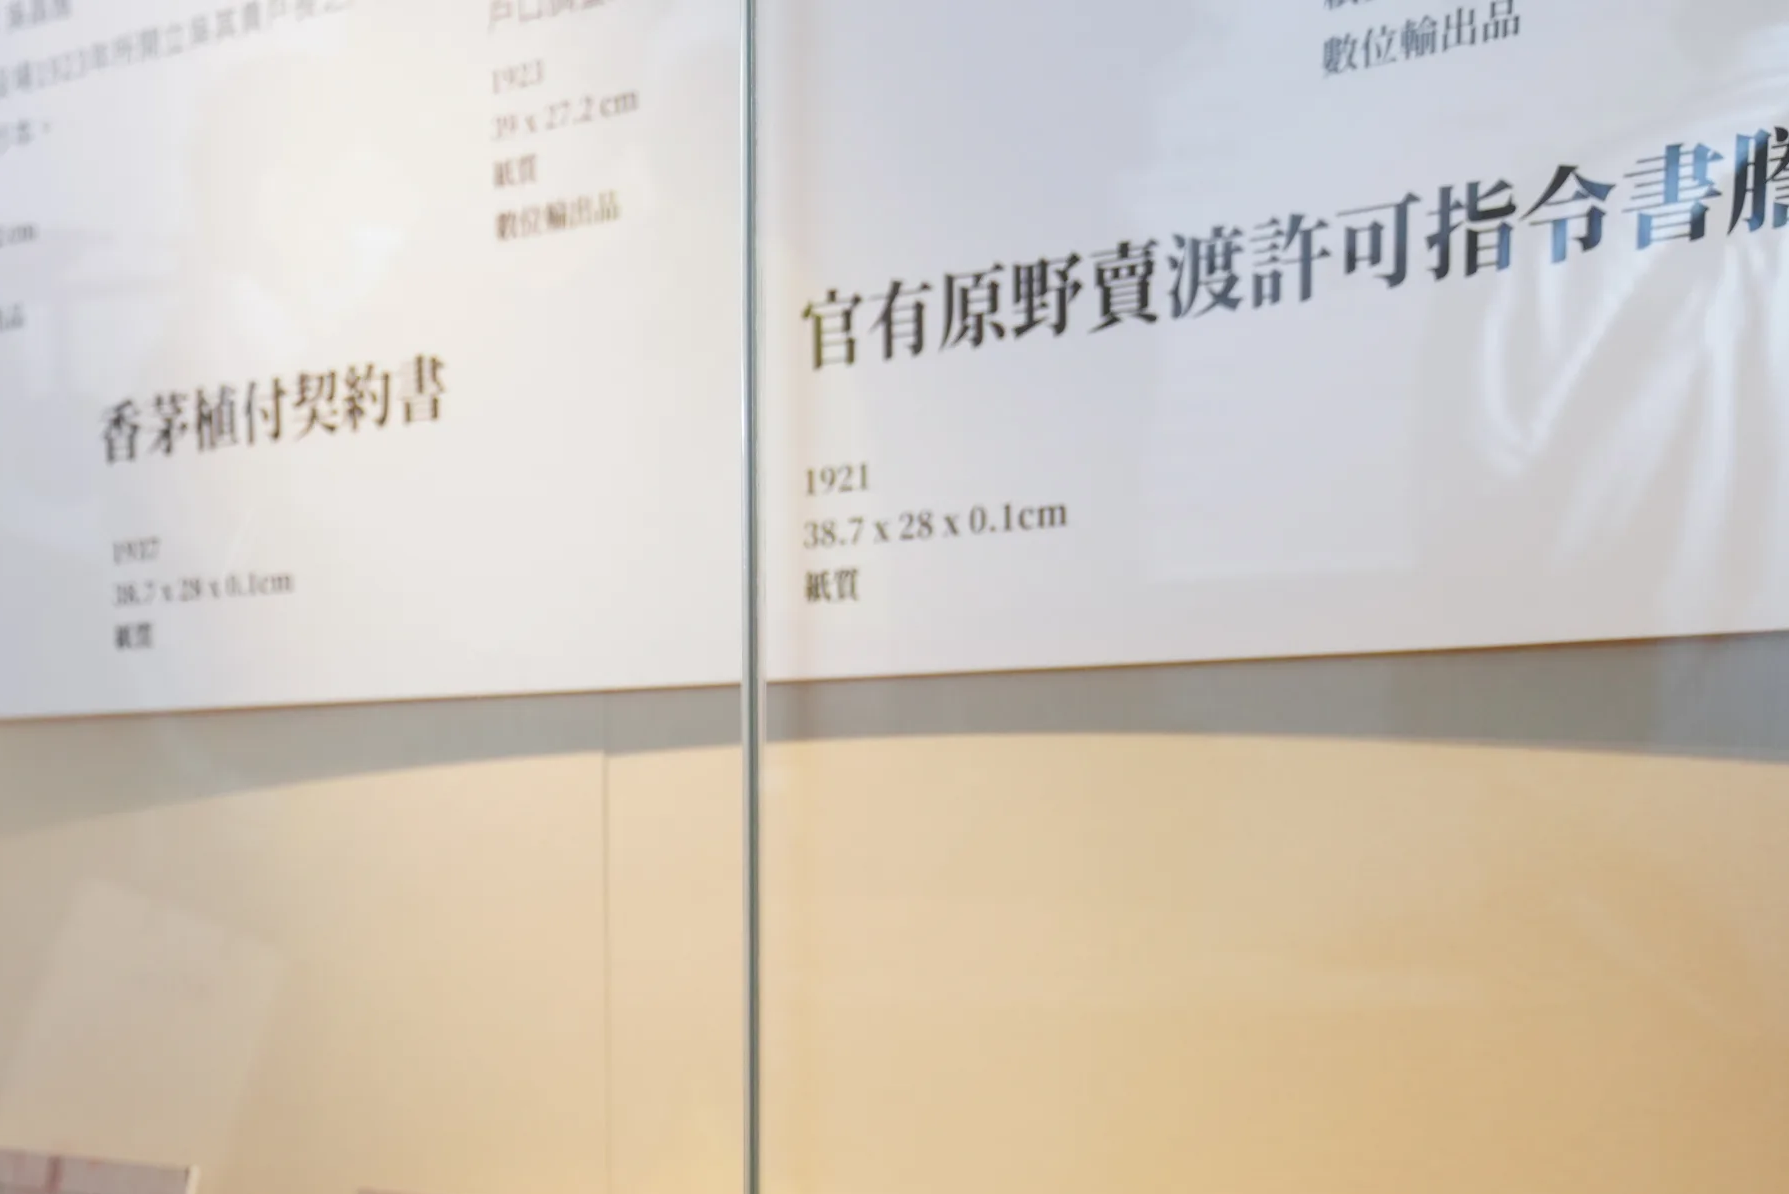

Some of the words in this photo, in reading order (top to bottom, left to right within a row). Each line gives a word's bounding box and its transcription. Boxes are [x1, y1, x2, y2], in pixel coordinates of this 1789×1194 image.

[1322, 0, 1521, 78] 數位輸出品
[491, 58, 545, 95] 1923
[543, 95, 595, 132] 27.2
[599, 89, 640, 119] cm
[101, 353, 445, 467] 香茅植付契約書
[805, 462, 869, 496] 1921
[803, 515, 864, 550] 38.7
[872, 518, 891, 544] x
[898, 510, 934, 542] 28
[942, 514, 962, 538] x
[968, 501, 1067, 536] 0.1cm
[805, 567, 859, 604] 紙質
